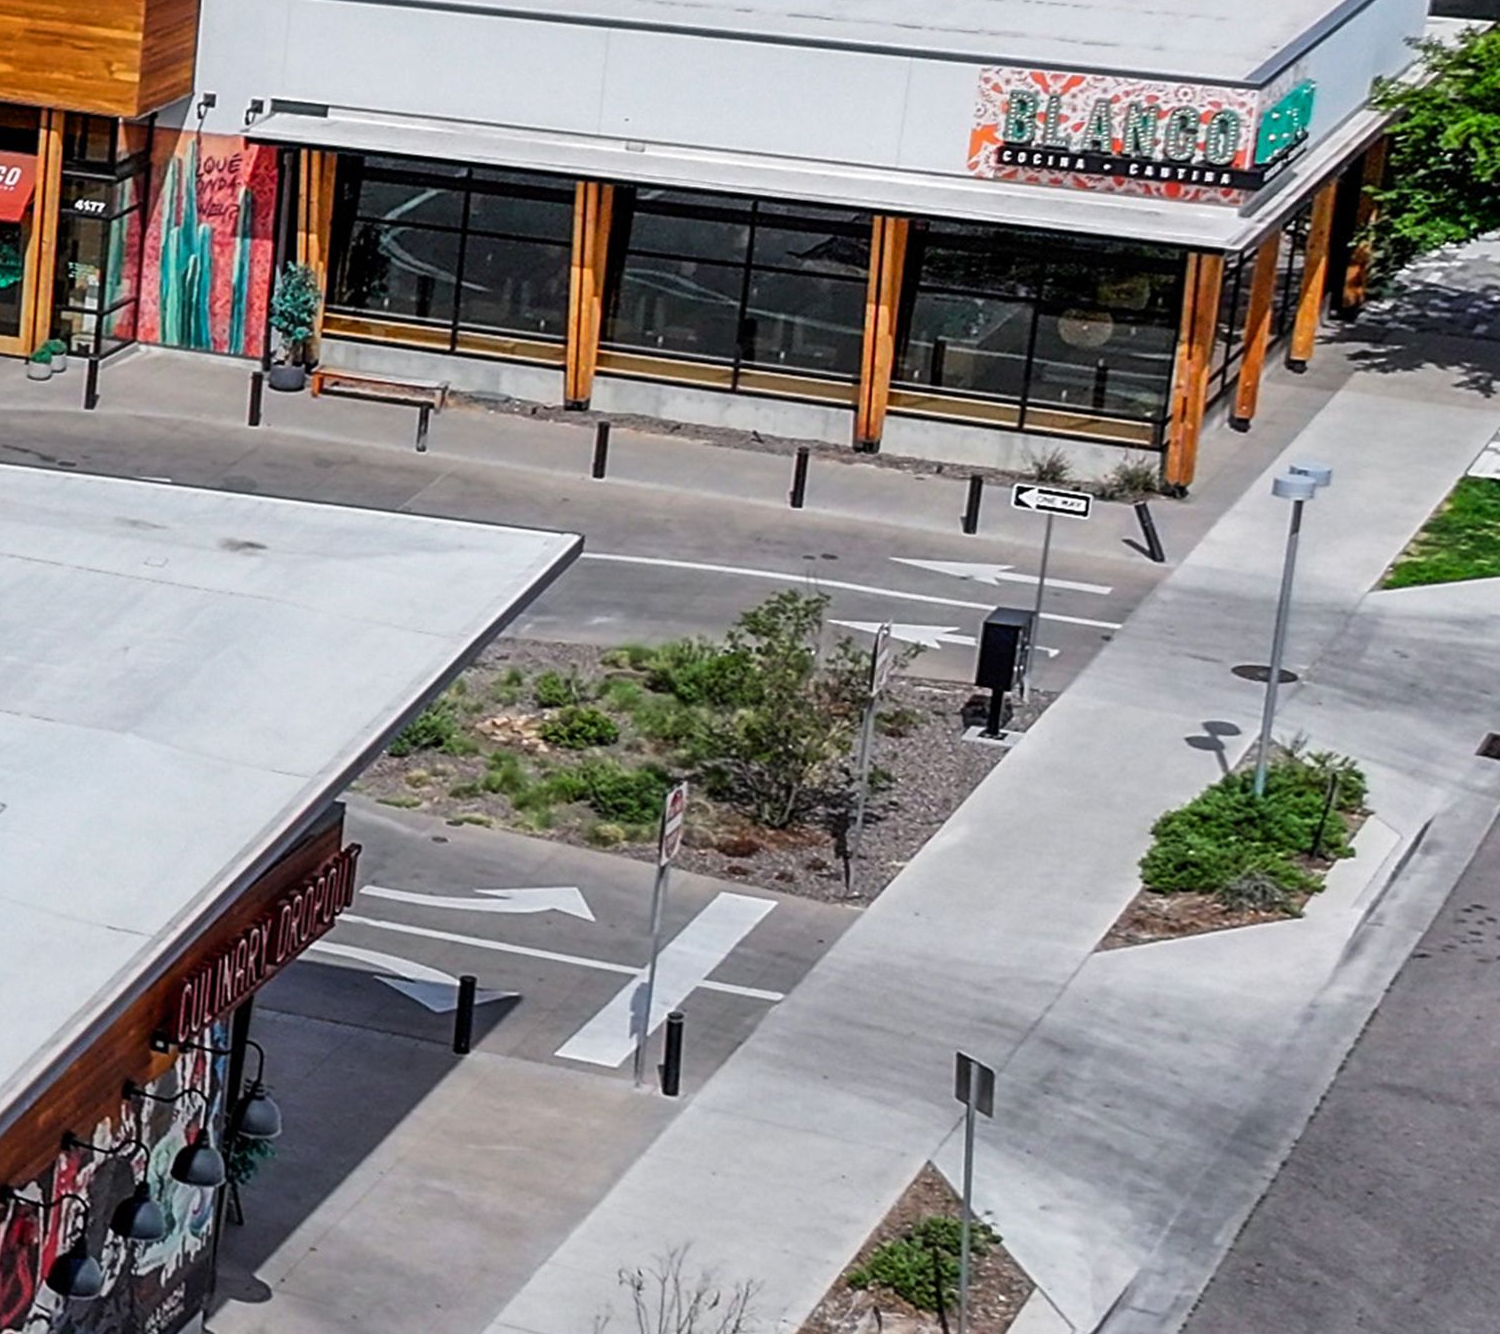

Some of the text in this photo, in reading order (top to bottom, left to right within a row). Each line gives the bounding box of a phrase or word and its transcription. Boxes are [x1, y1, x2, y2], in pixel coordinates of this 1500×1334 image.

[1002, 88, 1241, 165] BLANCO
[1001, 149, 1086, 170] COCINA
[1128, 163, 1232, 186] CANTINA
[74, 198, 107, 213] 4177
[1036, 495, 1082, 508] ONE WAY
[177, 843, 362, 1044] CULINARY DROPOUT
